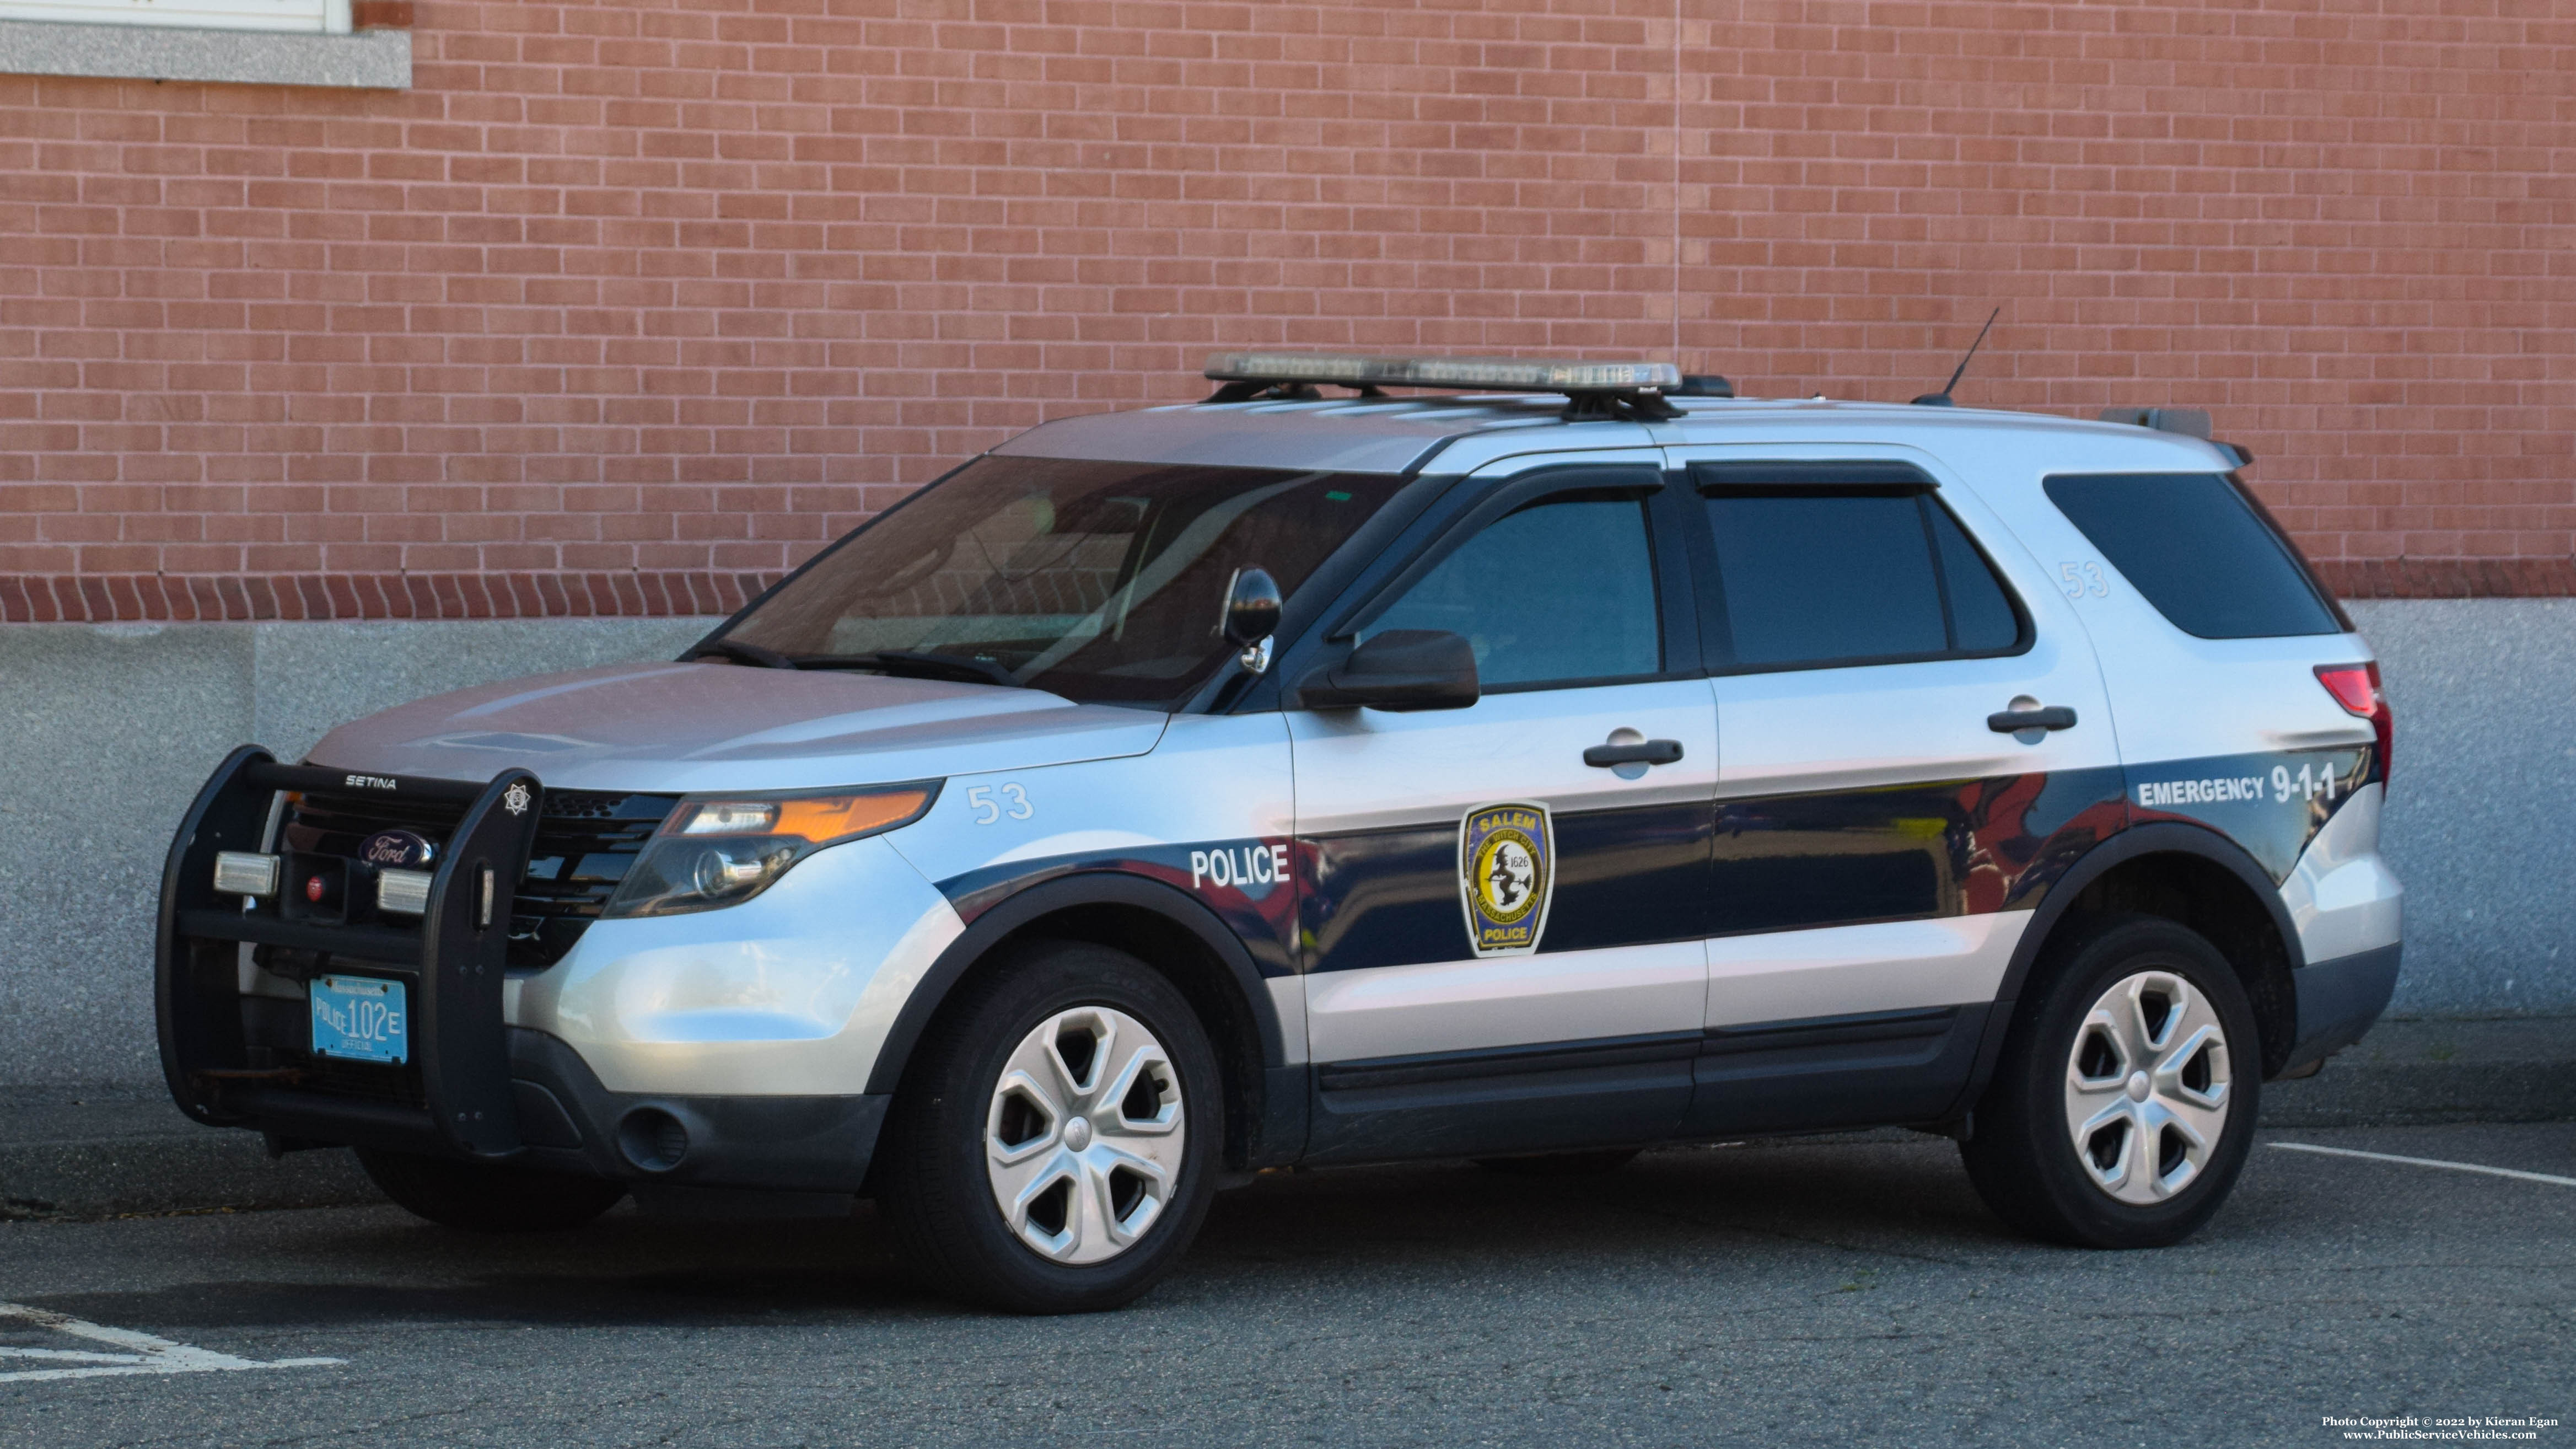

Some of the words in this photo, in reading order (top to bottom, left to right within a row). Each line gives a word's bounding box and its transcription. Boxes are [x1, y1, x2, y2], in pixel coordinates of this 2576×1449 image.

[2059, 560, 2110, 599] 53
[346, 775, 397, 790] SETINA
[2138, 776, 2264, 807] EMERGENCY
[2272, 762, 2336, 803] 9-1-1
[966, 781, 1035, 825] 53
[1478, 812, 1536, 831] SALEM
[368, 835, 411, 863] Ford
[1478, 839, 1493, 857] THE
[1493, 830, 1519, 841] WITCH
[1520, 836, 1536, 855] CITY
[1191, 844, 1290, 888] POLICE
[1511, 856, 1529, 868] 1626
[1477, 892, 1537, 921] MASSACHUSETTS
[1484, 927, 1528, 942] POLICE
[316, 996, 347, 1036] POLICE
